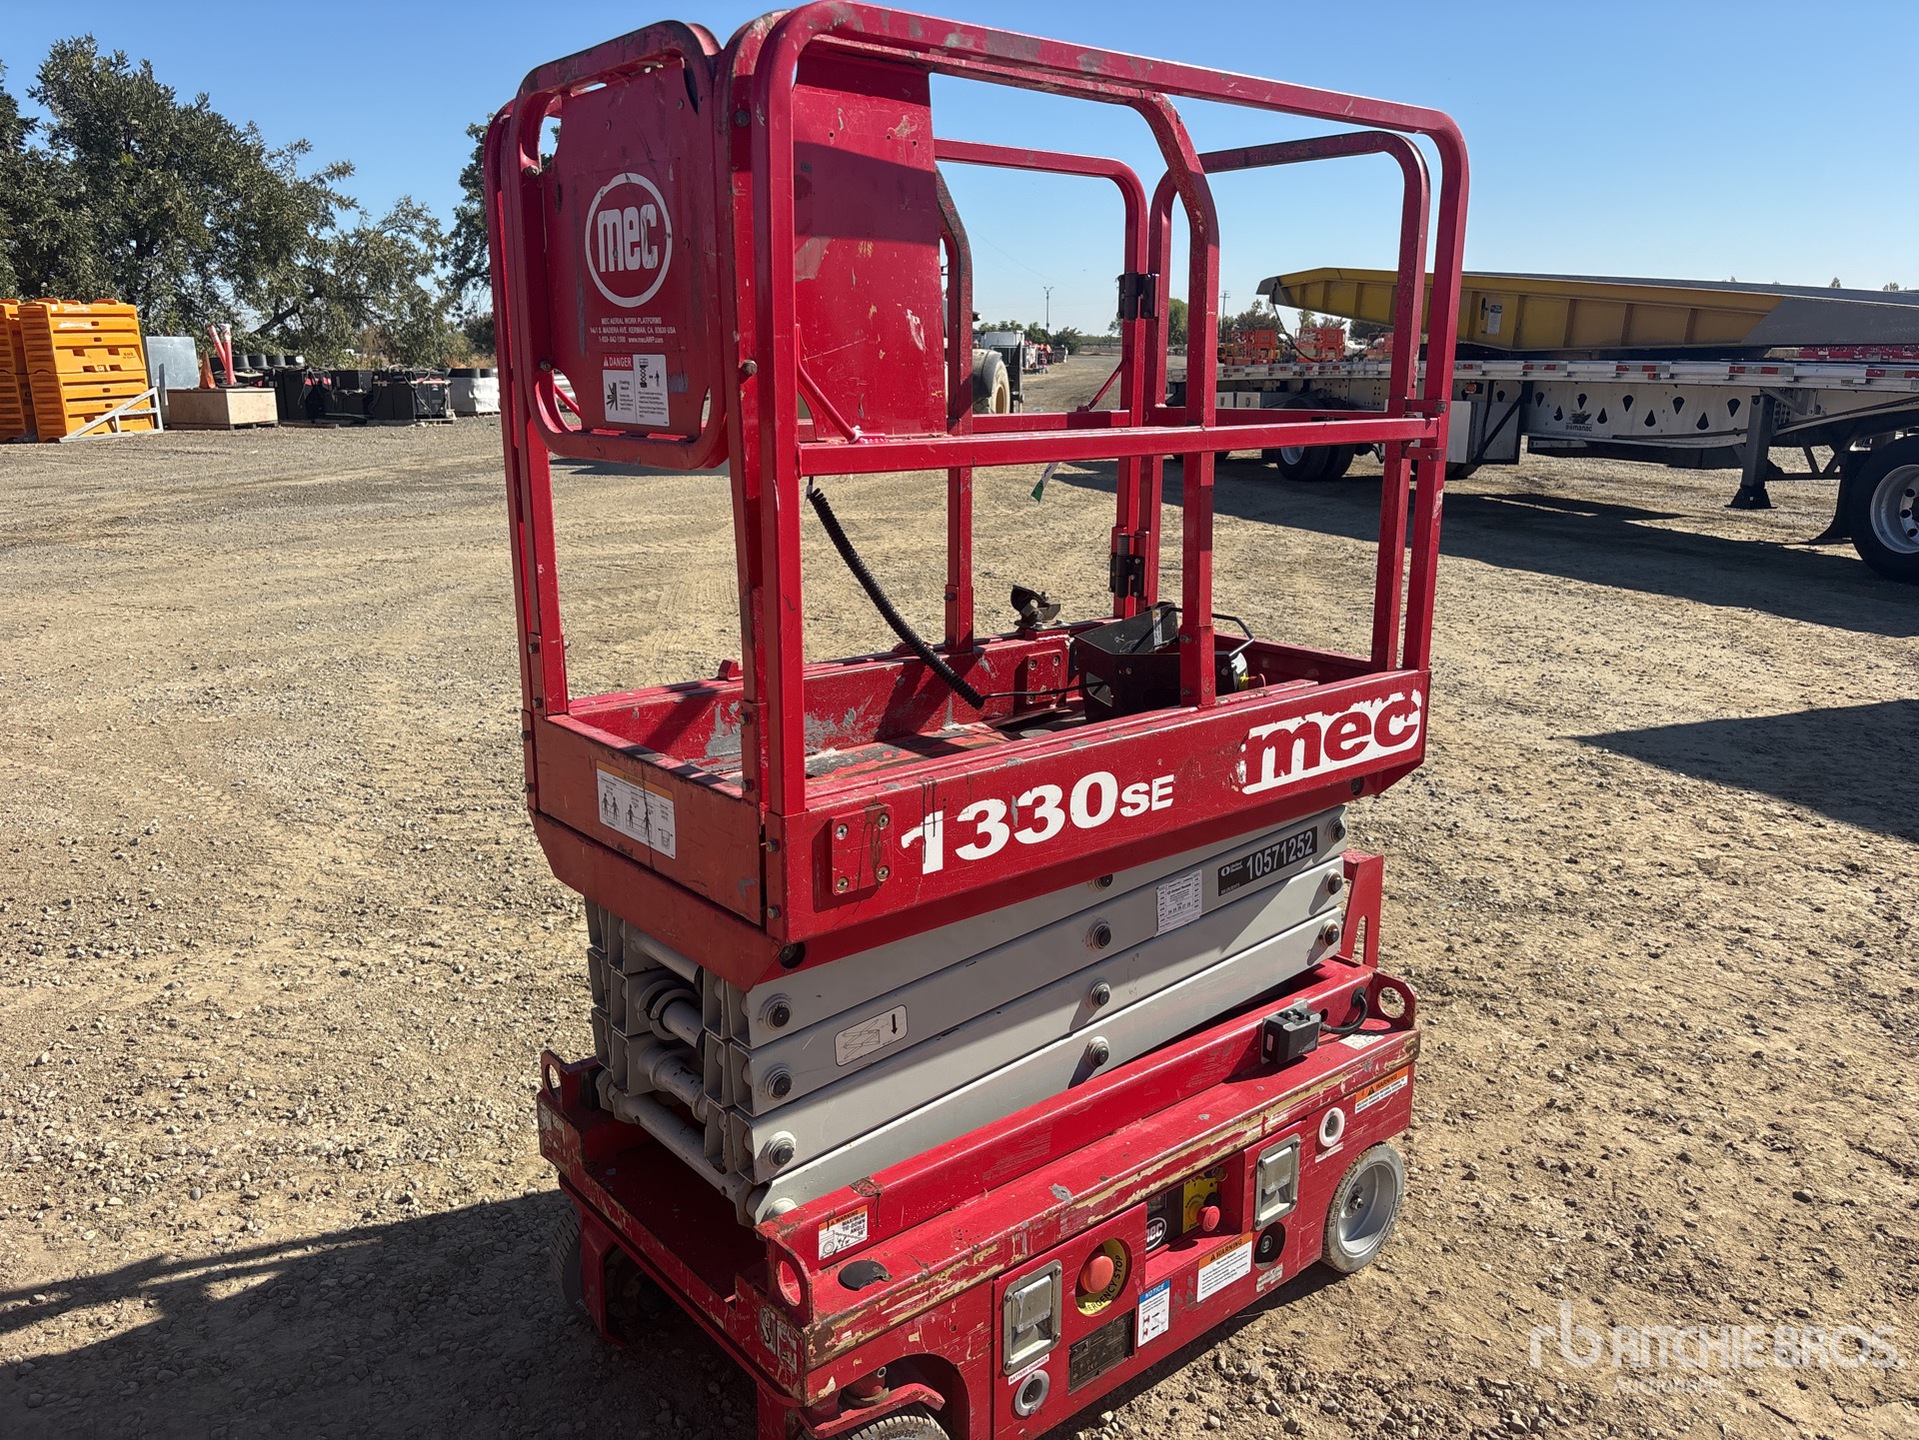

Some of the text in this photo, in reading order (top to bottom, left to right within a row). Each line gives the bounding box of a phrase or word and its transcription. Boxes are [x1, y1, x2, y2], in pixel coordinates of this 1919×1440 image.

[597, 203, 659, 273] mec
[624, 317, 637, 325] WORK
[637, 317, 662, 325] PLATFORMS
[609, 357, 632, 367] DANGER
[1243, 697, 1420, 786] mec
[1246, 831, 1313, 880] 10571252
[1376, 1074, 1398, 1090] WARNING
[836, 1210, 859, 1223] WARNING
[842, 1212, 866, 1226] MAXIMUM
[850, 1224, 866, 1234] ANGLE
[1216, 1239, 1243, 1257] WARNING
[1114, 1255, 1123, 1280] STOP
[1145, 1282, 1164, 1298] NOTICE
